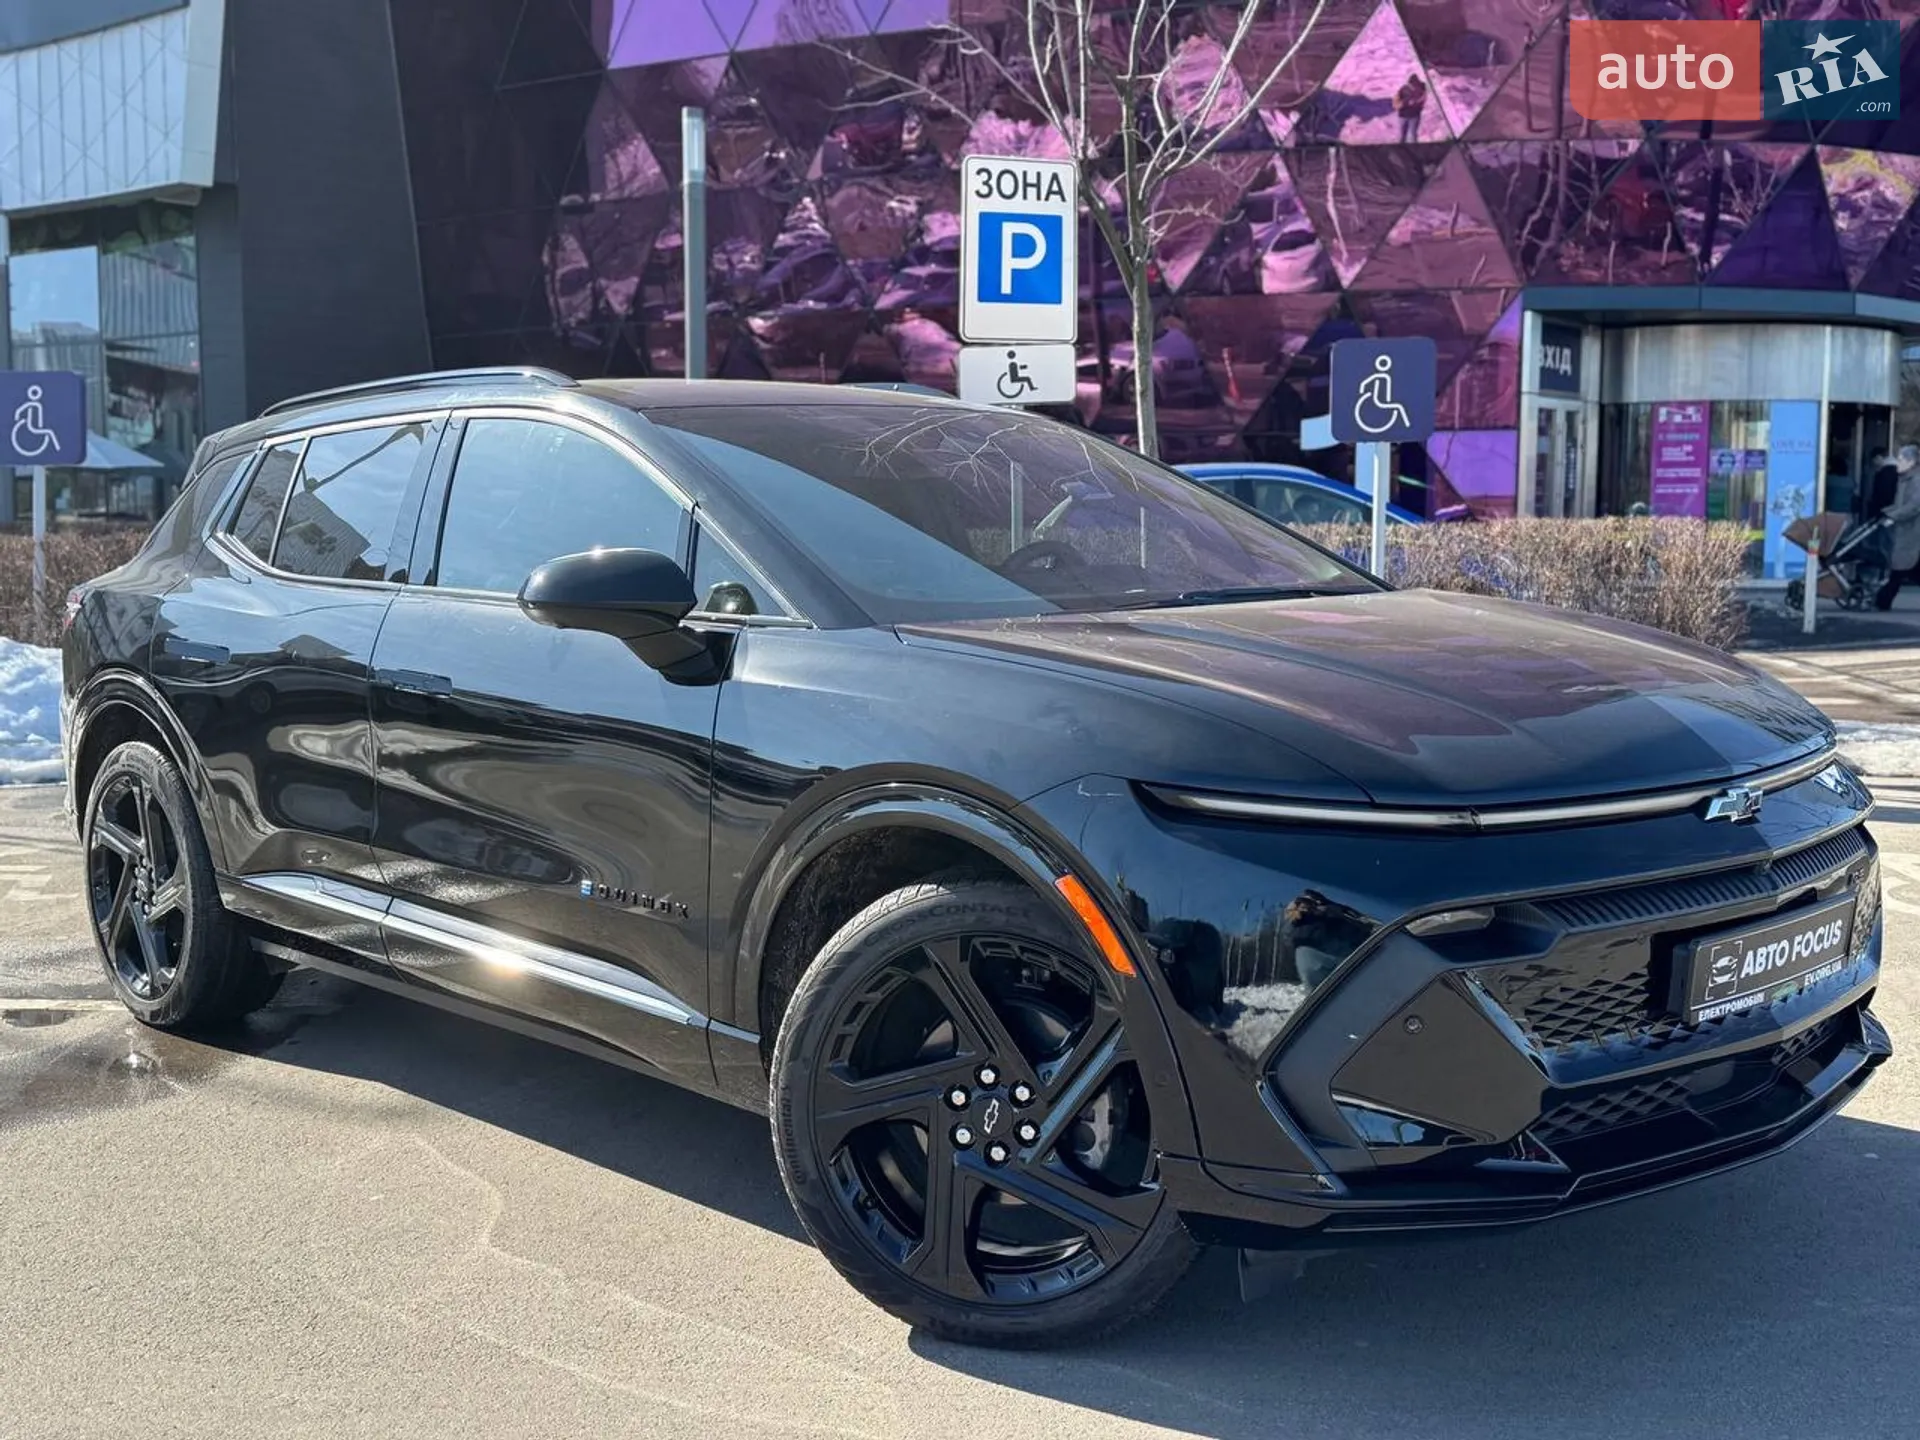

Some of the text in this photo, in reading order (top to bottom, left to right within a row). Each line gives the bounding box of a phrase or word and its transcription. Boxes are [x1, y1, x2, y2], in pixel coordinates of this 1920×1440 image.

[974, 167, 1067, 203] ЗОНА
[1000, 221, 1047, 295] P
[1740, 919, 1843, 979] АВТО FOCUS
